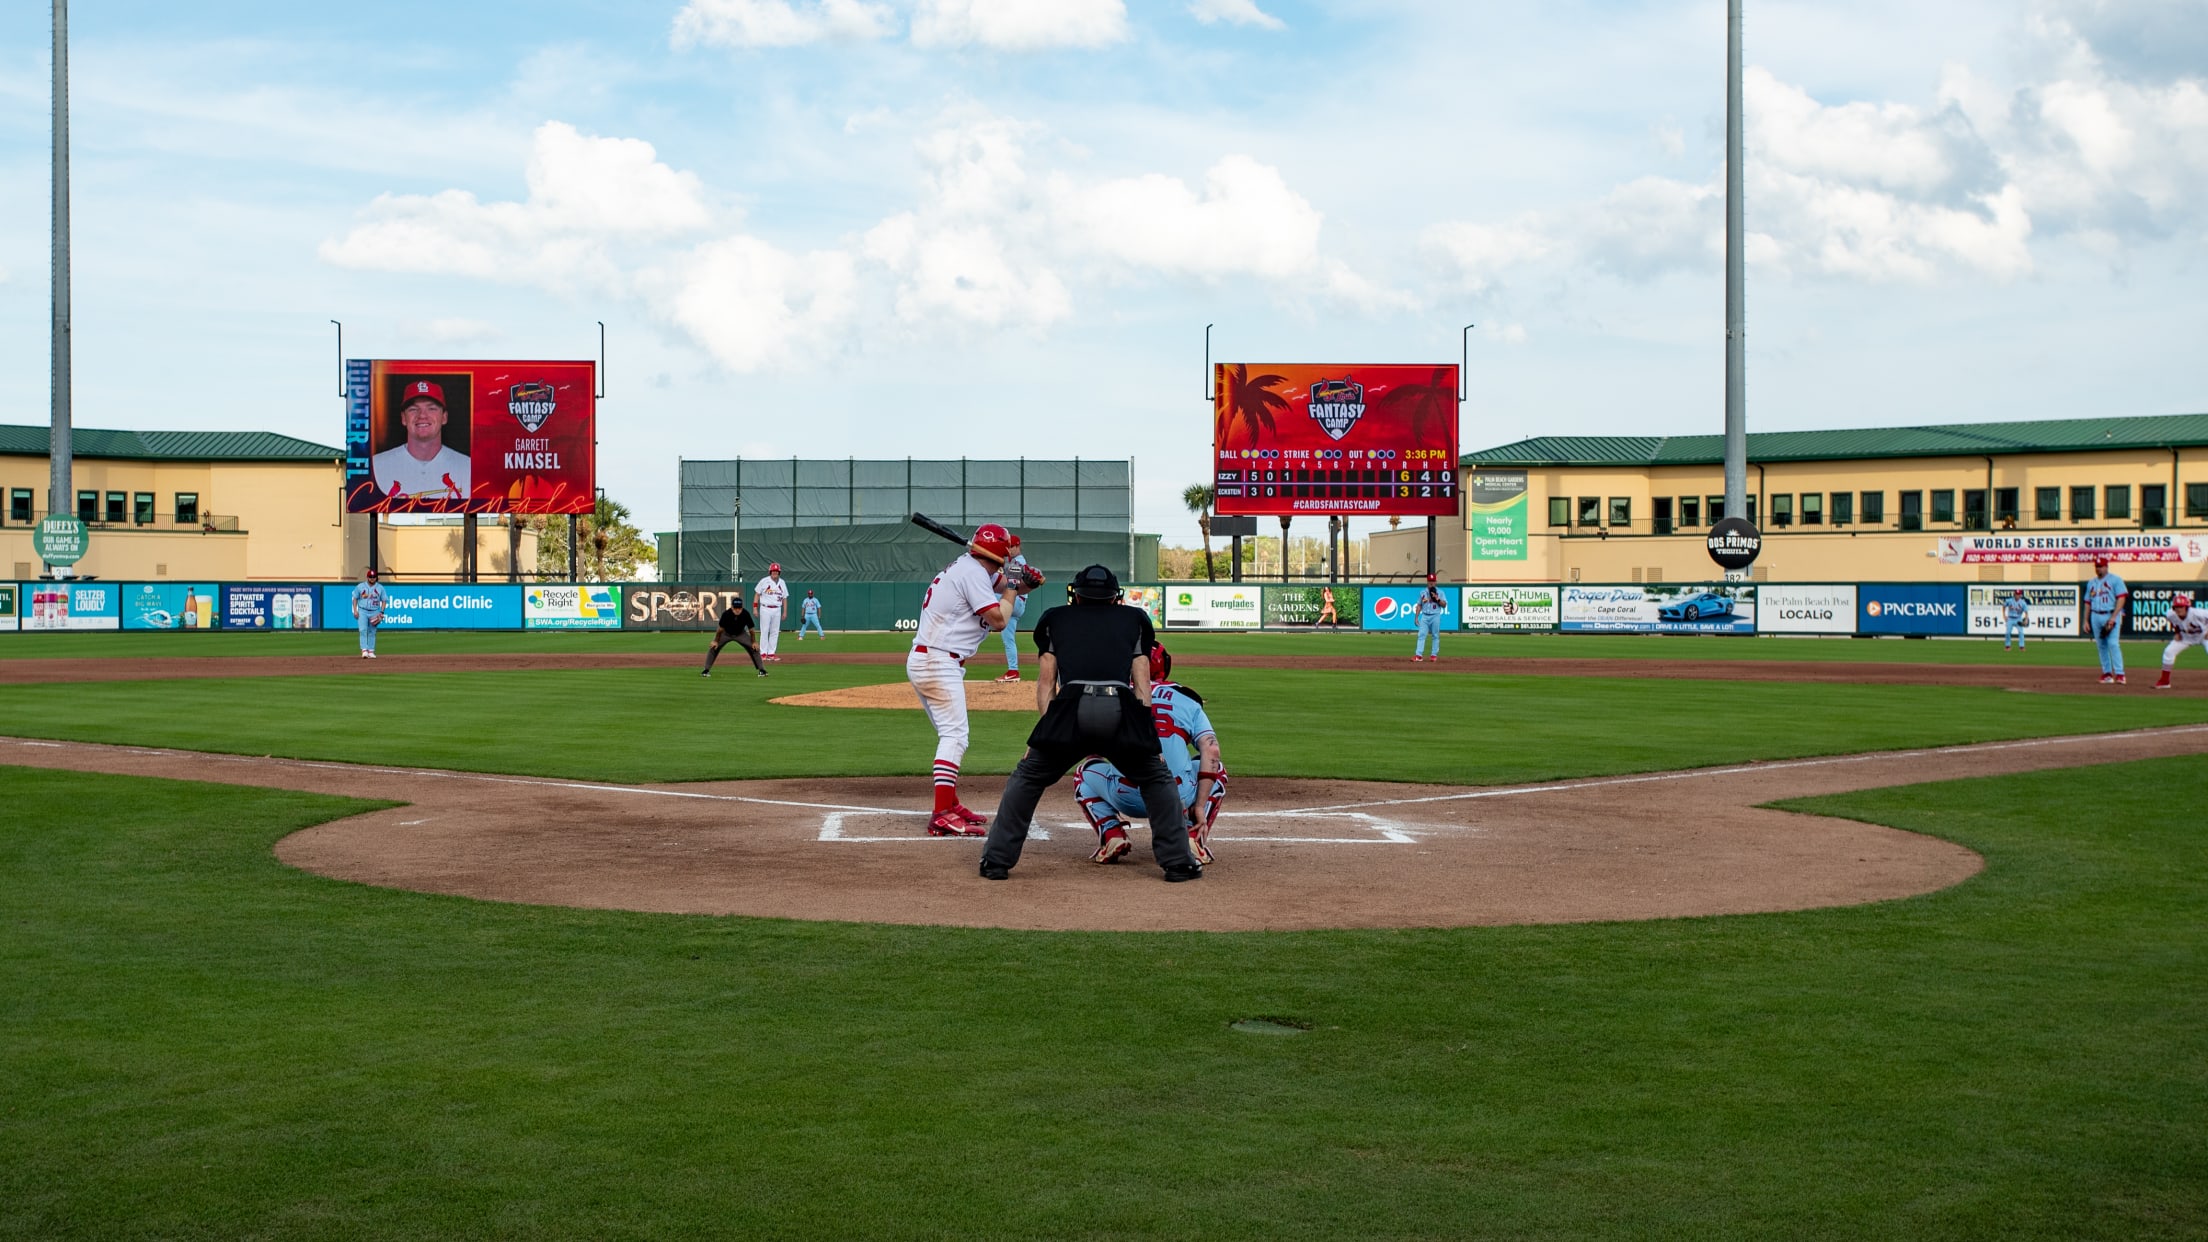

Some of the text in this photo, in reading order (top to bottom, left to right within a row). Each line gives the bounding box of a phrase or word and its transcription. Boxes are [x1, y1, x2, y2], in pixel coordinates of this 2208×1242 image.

[508, 401, 556, 415] FANTASY
[1308, 403, 1366, 419] FANTASY
[522, 414, 542, 423] CAMP
[1325, 418, 1349, 429] CAMP
[515, 438, 550, 451] GARRETT
[1220, 450, 1238, 459] BALL
[1283, 450, 1310, 459] STRIKE
[1348, 450, 1363, 459] OUT
[1405, 450, 1446, 459] 3:36 PM
[504, 452, 561, 470] KNASEL
[1252, 461, 1256, 469] 1
[1268, 461, 1273, 469] 2
[1284, 461, 1290, 469] 3
[1301, 461, 1306, 469] 4
[1317, 461, 1322, 469] 5
[1333, 461, 1339, 469] 6
[1350, 461, 1355, 469] 7
[1402, 461, 1407, 469] R
[1423, 461, 1428, 469] H
[1443, 461, 1448, 469] E
[1251, 472, 1258, 481] 5
[1266, 472, 1273, 481] 0
[1284, 472, 1289, 481] 1
[1400, 471, 1409, 482] 6
[1421, 471, 1430, 482] 4
[1441, 471, 1451, 482] 0
[1251, 487, 1257, 496] 3
[1266, 487, 1273, 496] 0
[1400, 486, 1409, 497] 3
[1421, 486, 1431, 497] 2
[1443, 486, 1450, 497] 1
[347, 481, 595, 513] Cardinals
[1293, 500, 1381, 509] #CARDSFANTASYCAMP
[1486, 517, 1513, 526] Nearly
[1487, 527, 1512, 535] 19,000
[74, 536, 80, 544] IS
[1475, 538, 1497, 546] Open
[1708, 536, 1758, 549] DOS PRIMOS
[1973, 536, 2171, 549] WORLD SERIES CHAMPIONS
[1481, 548, 1517, 557] Surgeries
[75, 590, 105, 600] SELTZER
[543, 589, 578, 599] Recycle
[1282, 593, 1305, 601] THE
[1471, 590, 1509, 600] GREEN
[1568, 589, 1643, 604] Roger Dean
[2132, 590, 2155, 600] ONE
[2157, 590, 2172, 600] OF
[75, 600, 105, 611] LOUDLY
[452, 595, 493, 609] Clinic
[548, 598, 573, 608] Right
[1211, 599, 1255, 610] Everglades
[1765, 597, 1849, 605] The Palm Beach Post
[1268, 603, 1320, 612] GARDENS
[1597, 606, 1616, 614] Cape
[1883, 602, 1915, 616] PNC
[1915, 603, 1956, 617] BANK
[535, 618, 618, 627] SWA.org/RecycleRight
[895, 618, 918, 629] 400
[1279, 614, 1309, 623] MALL
